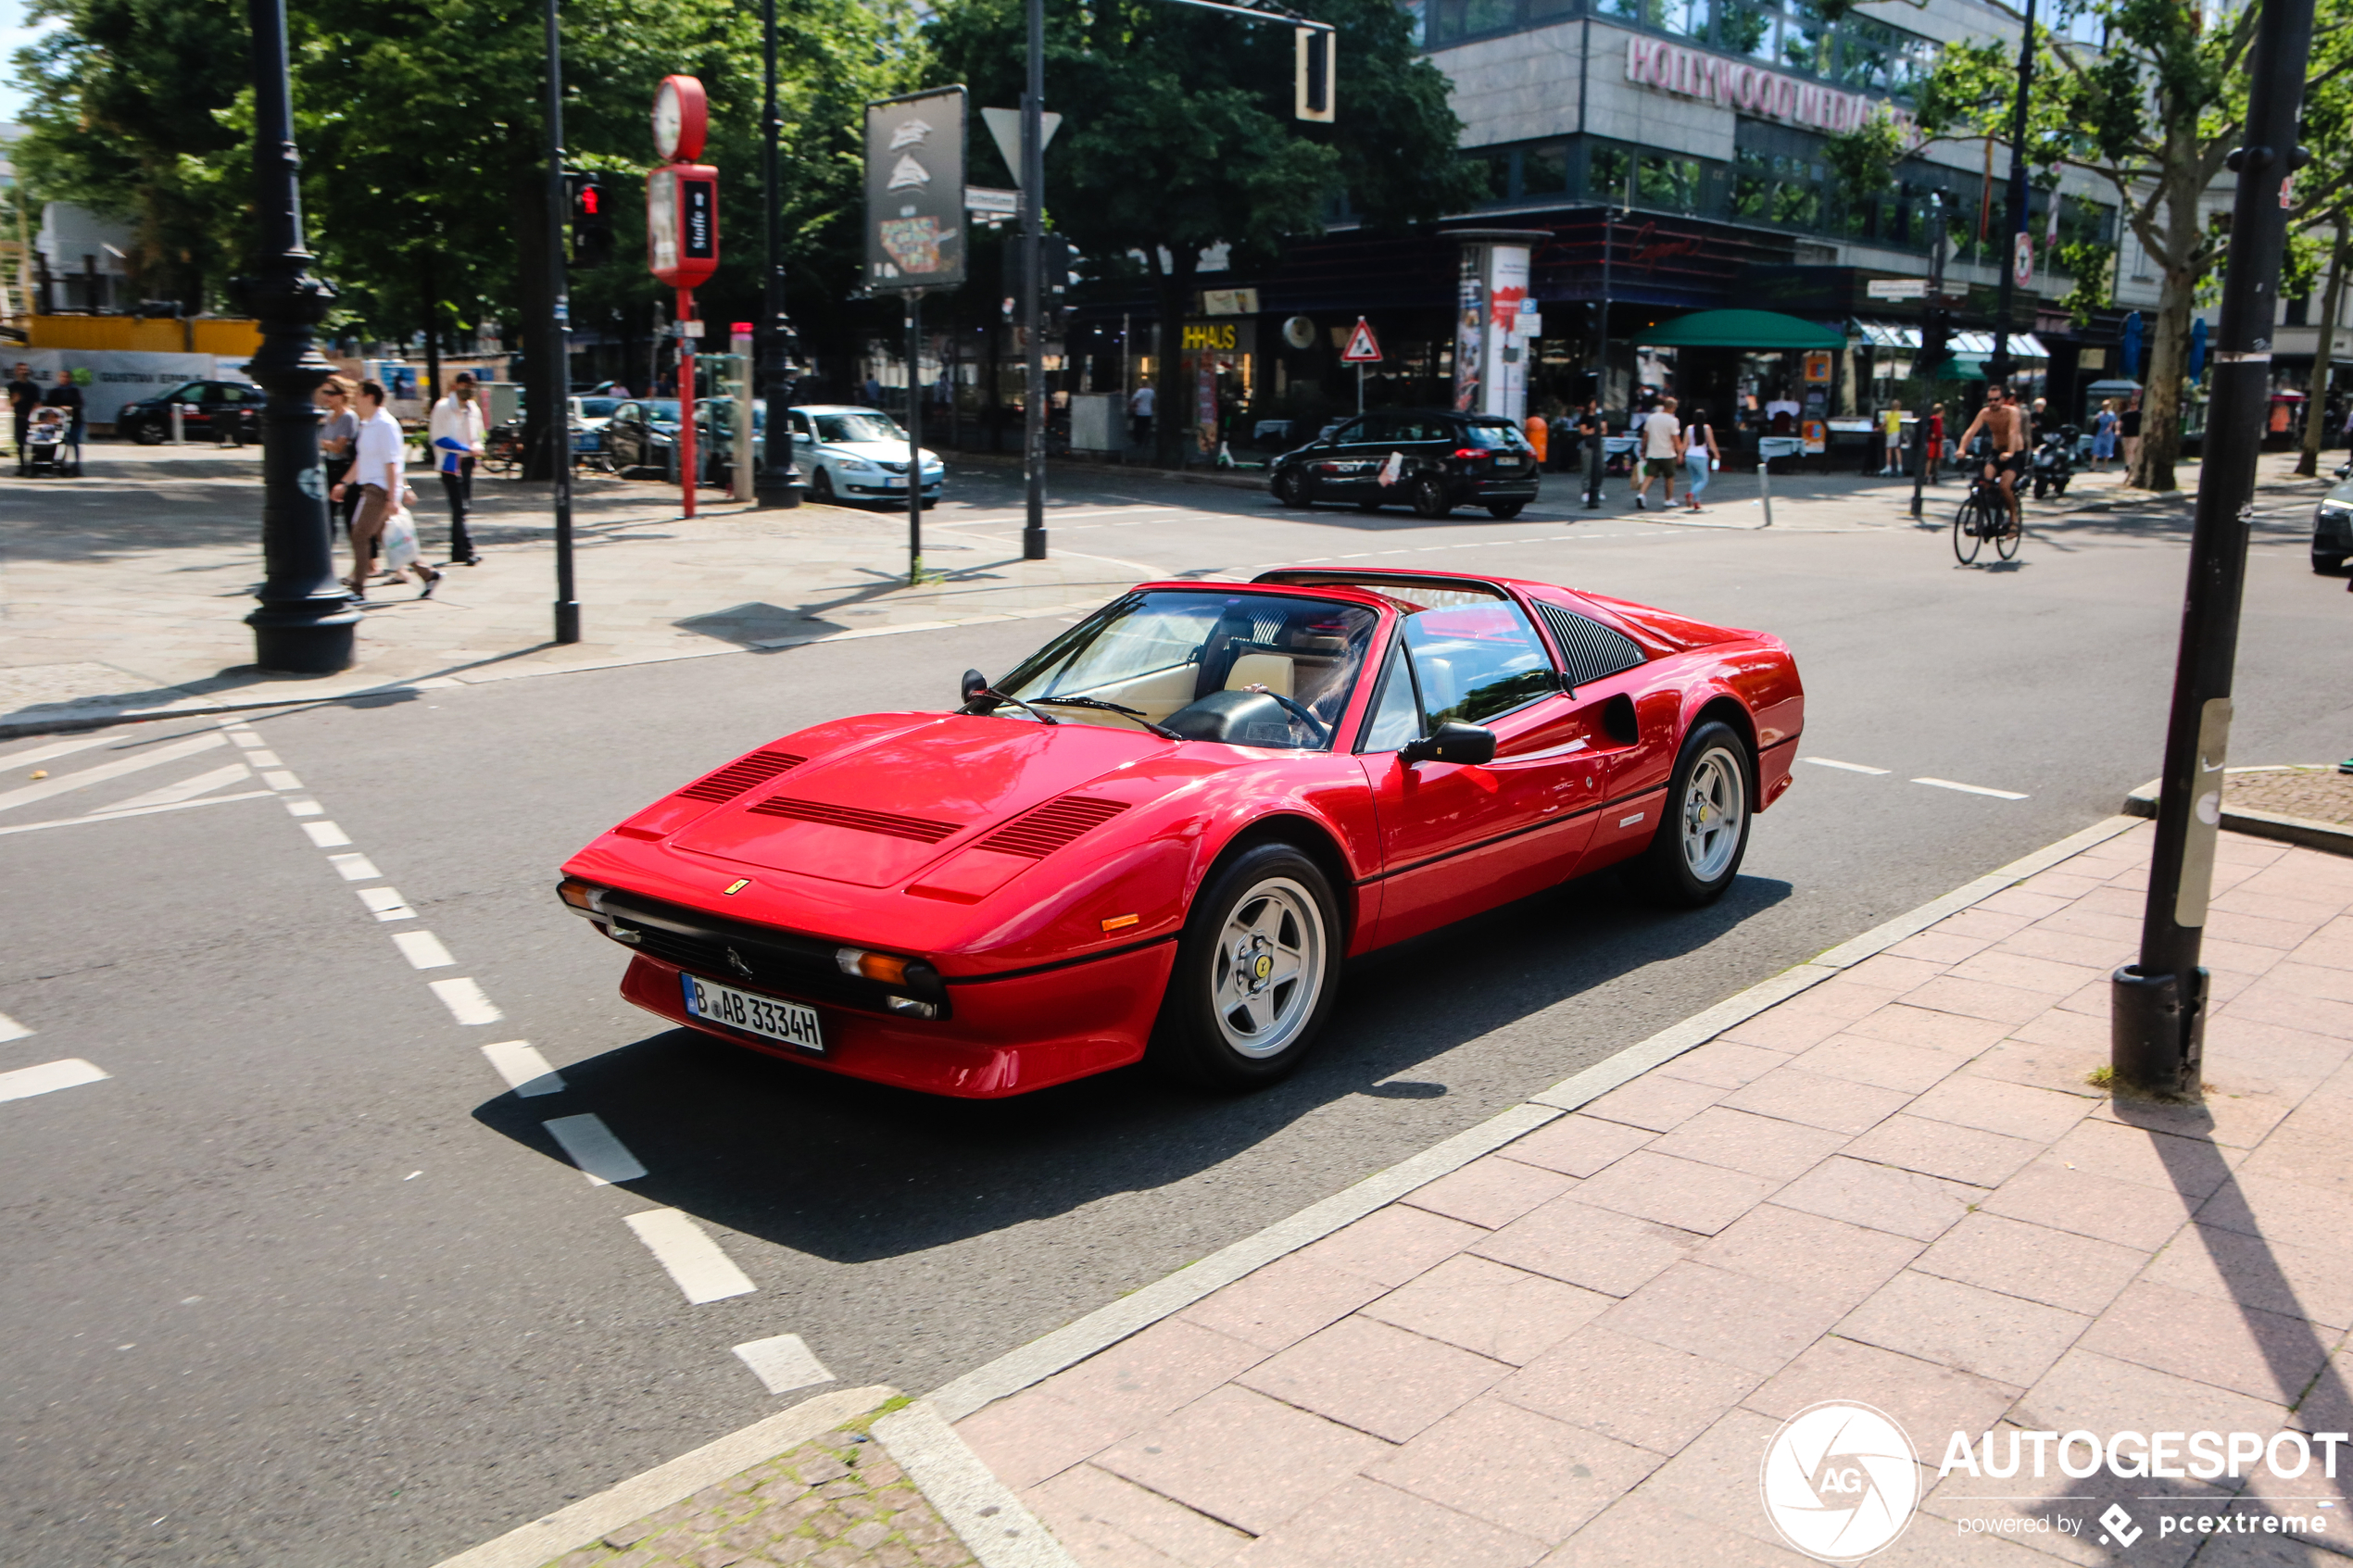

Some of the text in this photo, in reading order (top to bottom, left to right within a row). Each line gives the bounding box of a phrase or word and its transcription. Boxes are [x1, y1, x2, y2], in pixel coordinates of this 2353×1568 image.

[1628, 35, 1794, 118] HOLLYWOOD
[695, 982, 708, 1013] B
[722, 990, 747, 1025] AB
[749, 997, 818, 1045] 3334H
